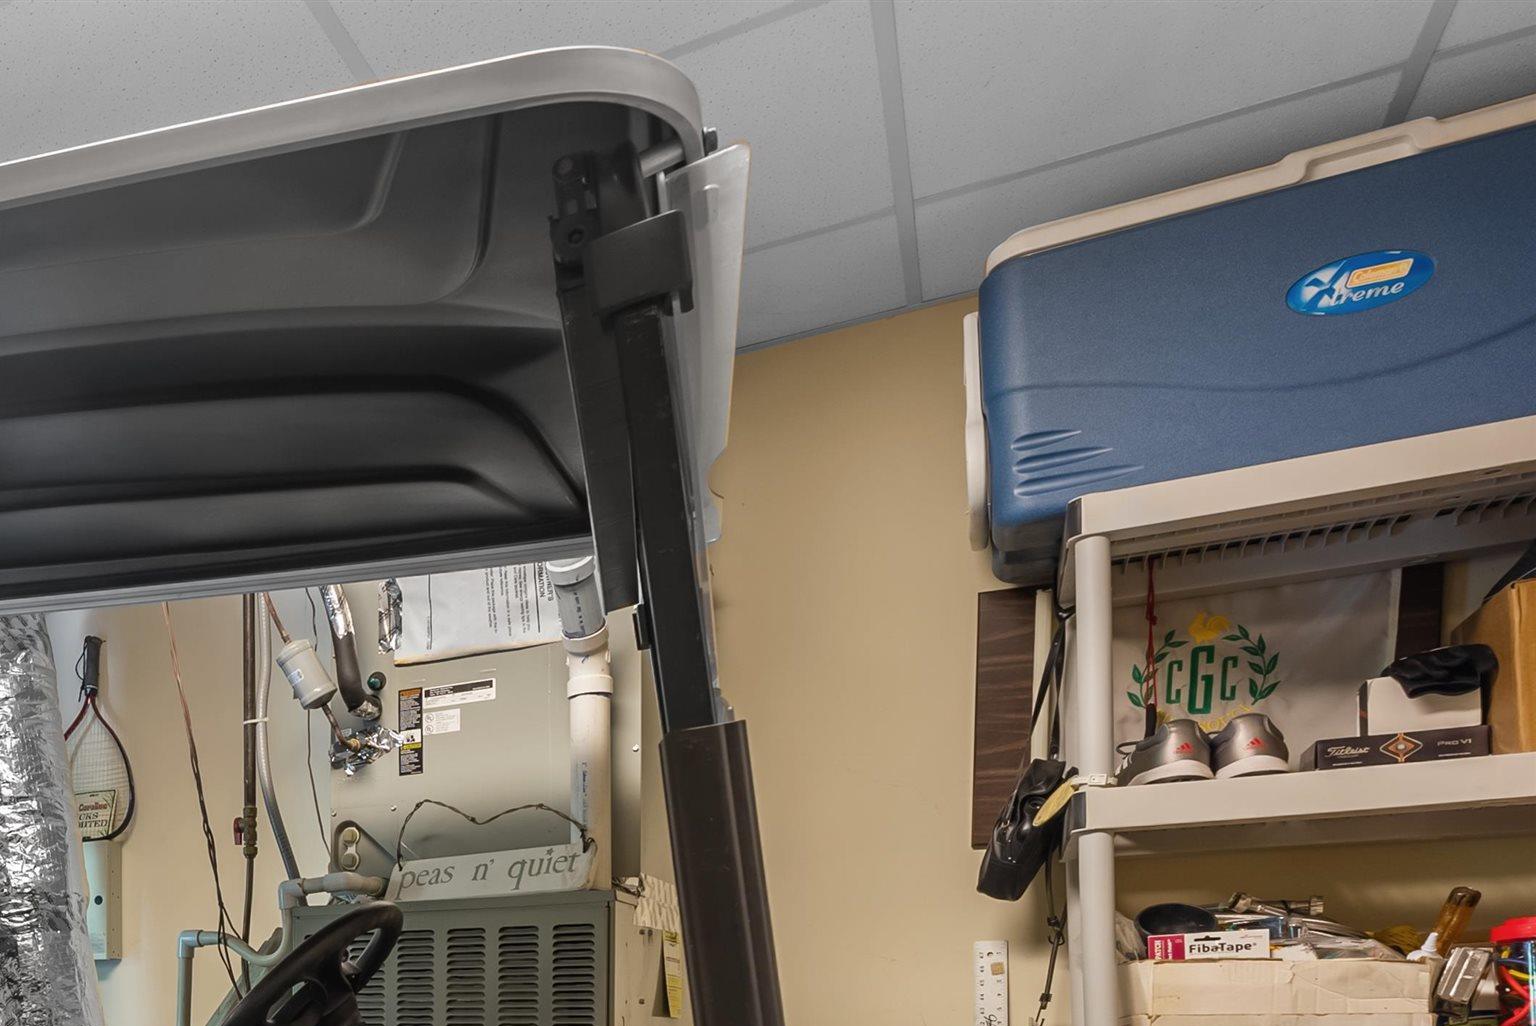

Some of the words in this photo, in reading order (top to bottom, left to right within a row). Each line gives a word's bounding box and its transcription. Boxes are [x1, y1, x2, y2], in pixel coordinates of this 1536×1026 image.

[1166, 645, 1239, 715] CGC
[1325, 745, 1370, 758] Titleist
[396, 865, 455, 900] peas
[472, 859, 495, 881] n'
[508, 848, 580, 891] quiet
